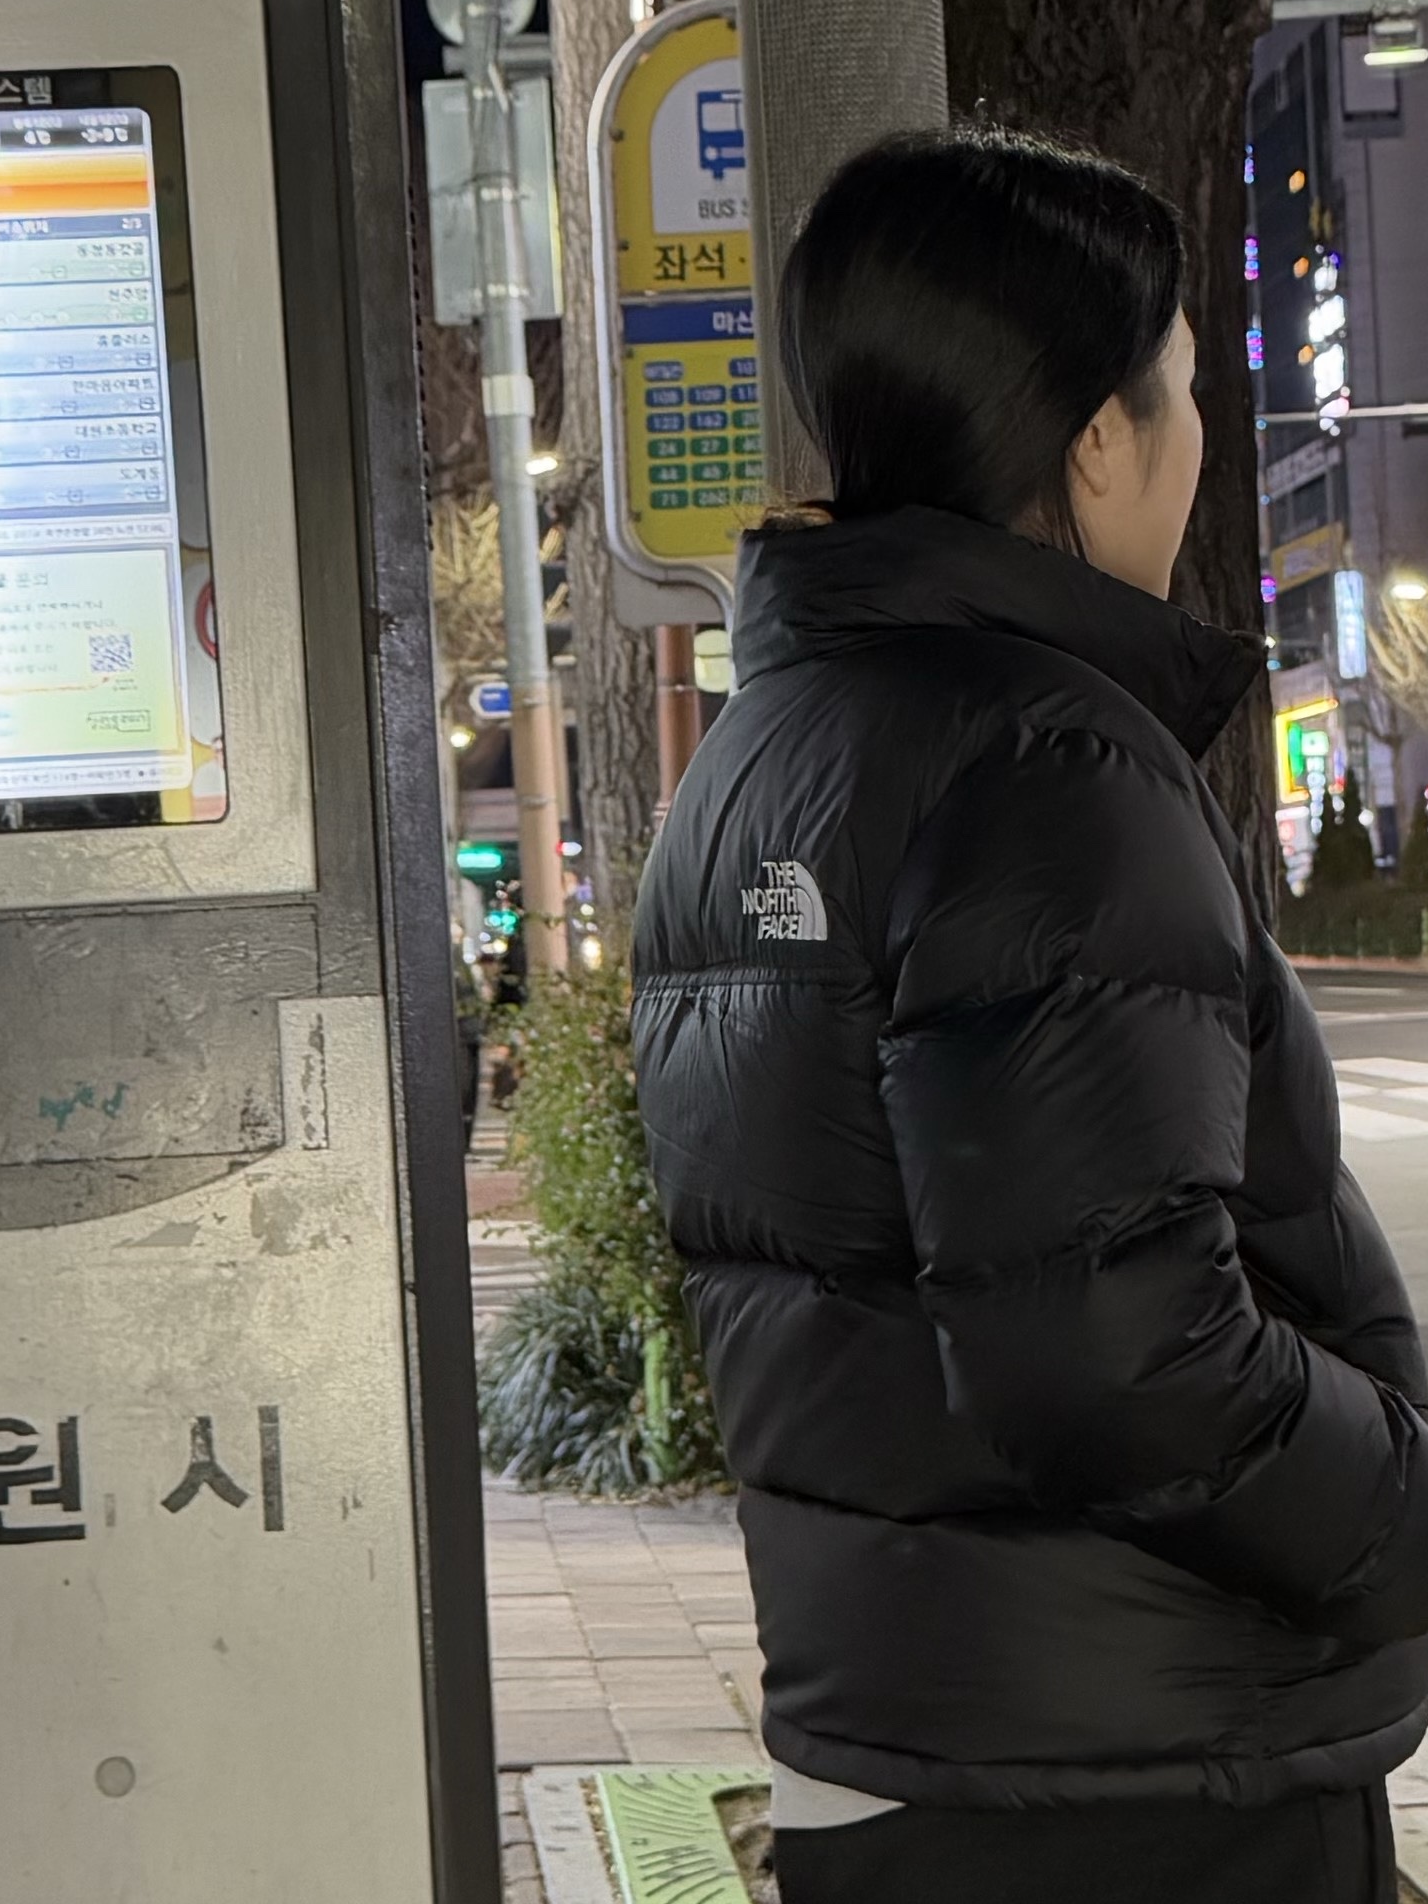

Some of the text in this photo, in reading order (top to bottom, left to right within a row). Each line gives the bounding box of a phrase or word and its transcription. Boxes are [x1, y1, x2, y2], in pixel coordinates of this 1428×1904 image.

[698, 197, 737, 220] BUS
[653, 240, 727, 283] 좌석
[761, 860, 796, 888] THE
[740, 888, 798, 915] NORTH
[757, 914, 799, 941] FACE
